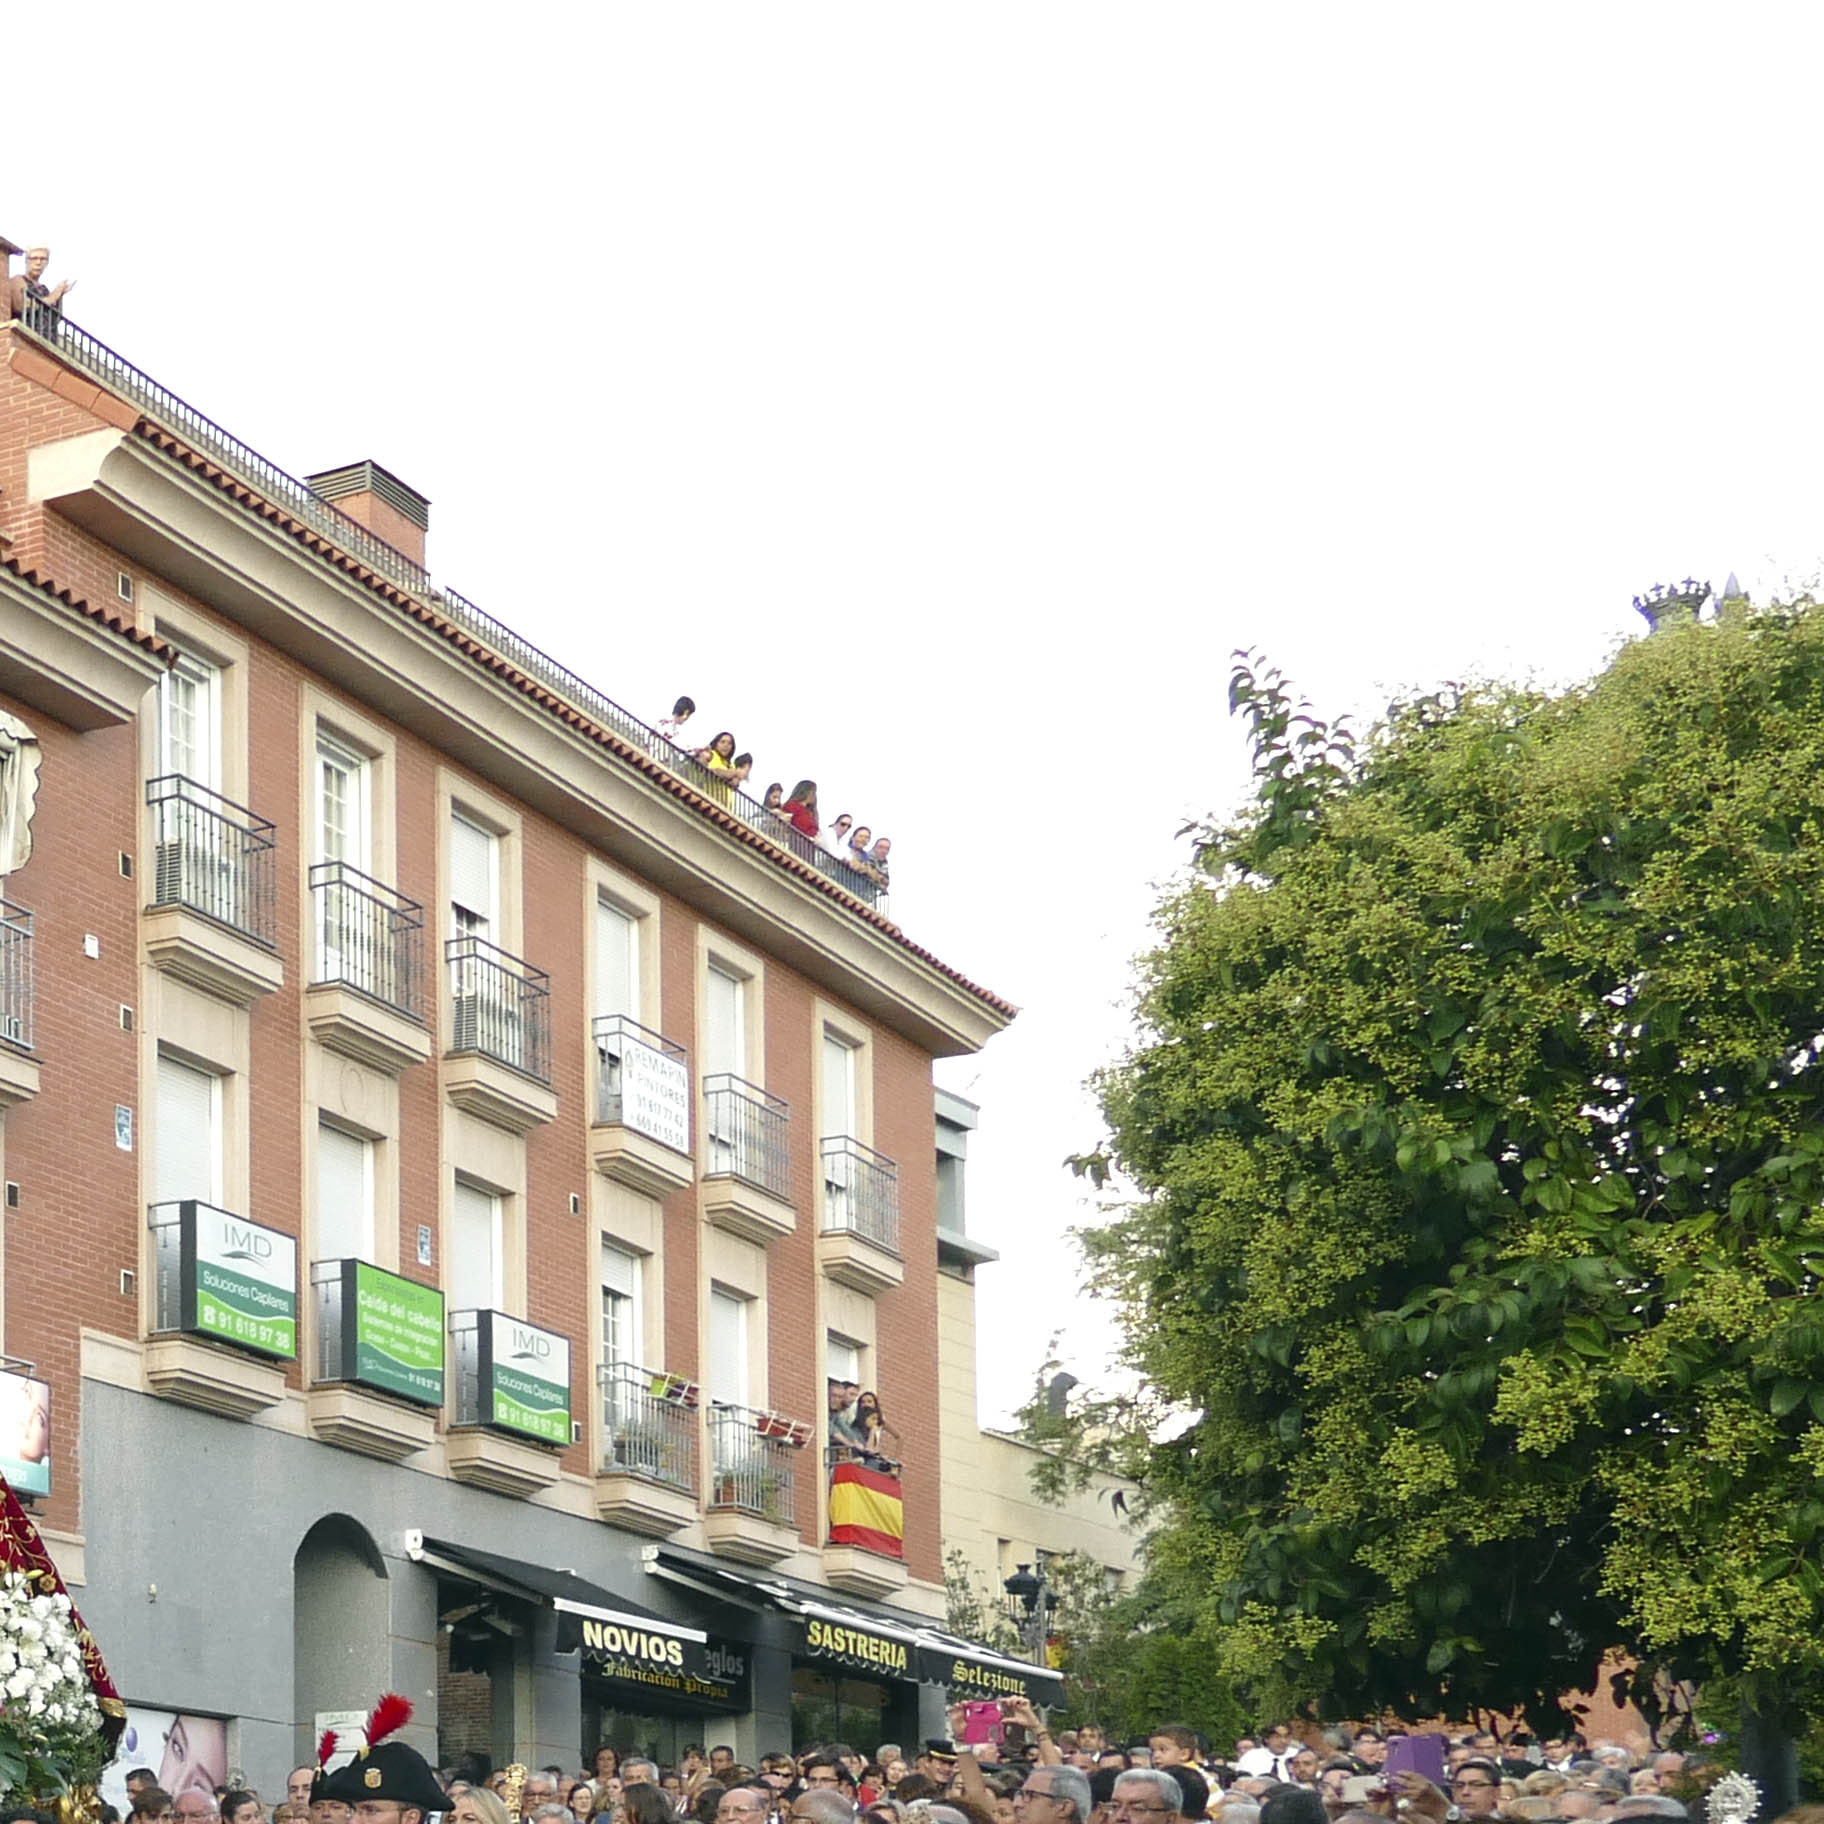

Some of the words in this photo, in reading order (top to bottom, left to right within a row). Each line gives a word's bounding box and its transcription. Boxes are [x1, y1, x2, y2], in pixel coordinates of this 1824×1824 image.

[224, 1223, 273, 1259] IMD
[203, 1270, 250, 1299] Soluciones
[218, 1311, 232, 1330] 91
[235, 1317, 257, 1339] 618
[259, 1325, 273, 1343] 97
[513, 1327, 551, 1357] IMD
[582, 1620, 684, 1667] NOVIOS
[807, 1620, 908, 1671] SASTRERIA
[952, 1660, 1027, 1695] Selezione
